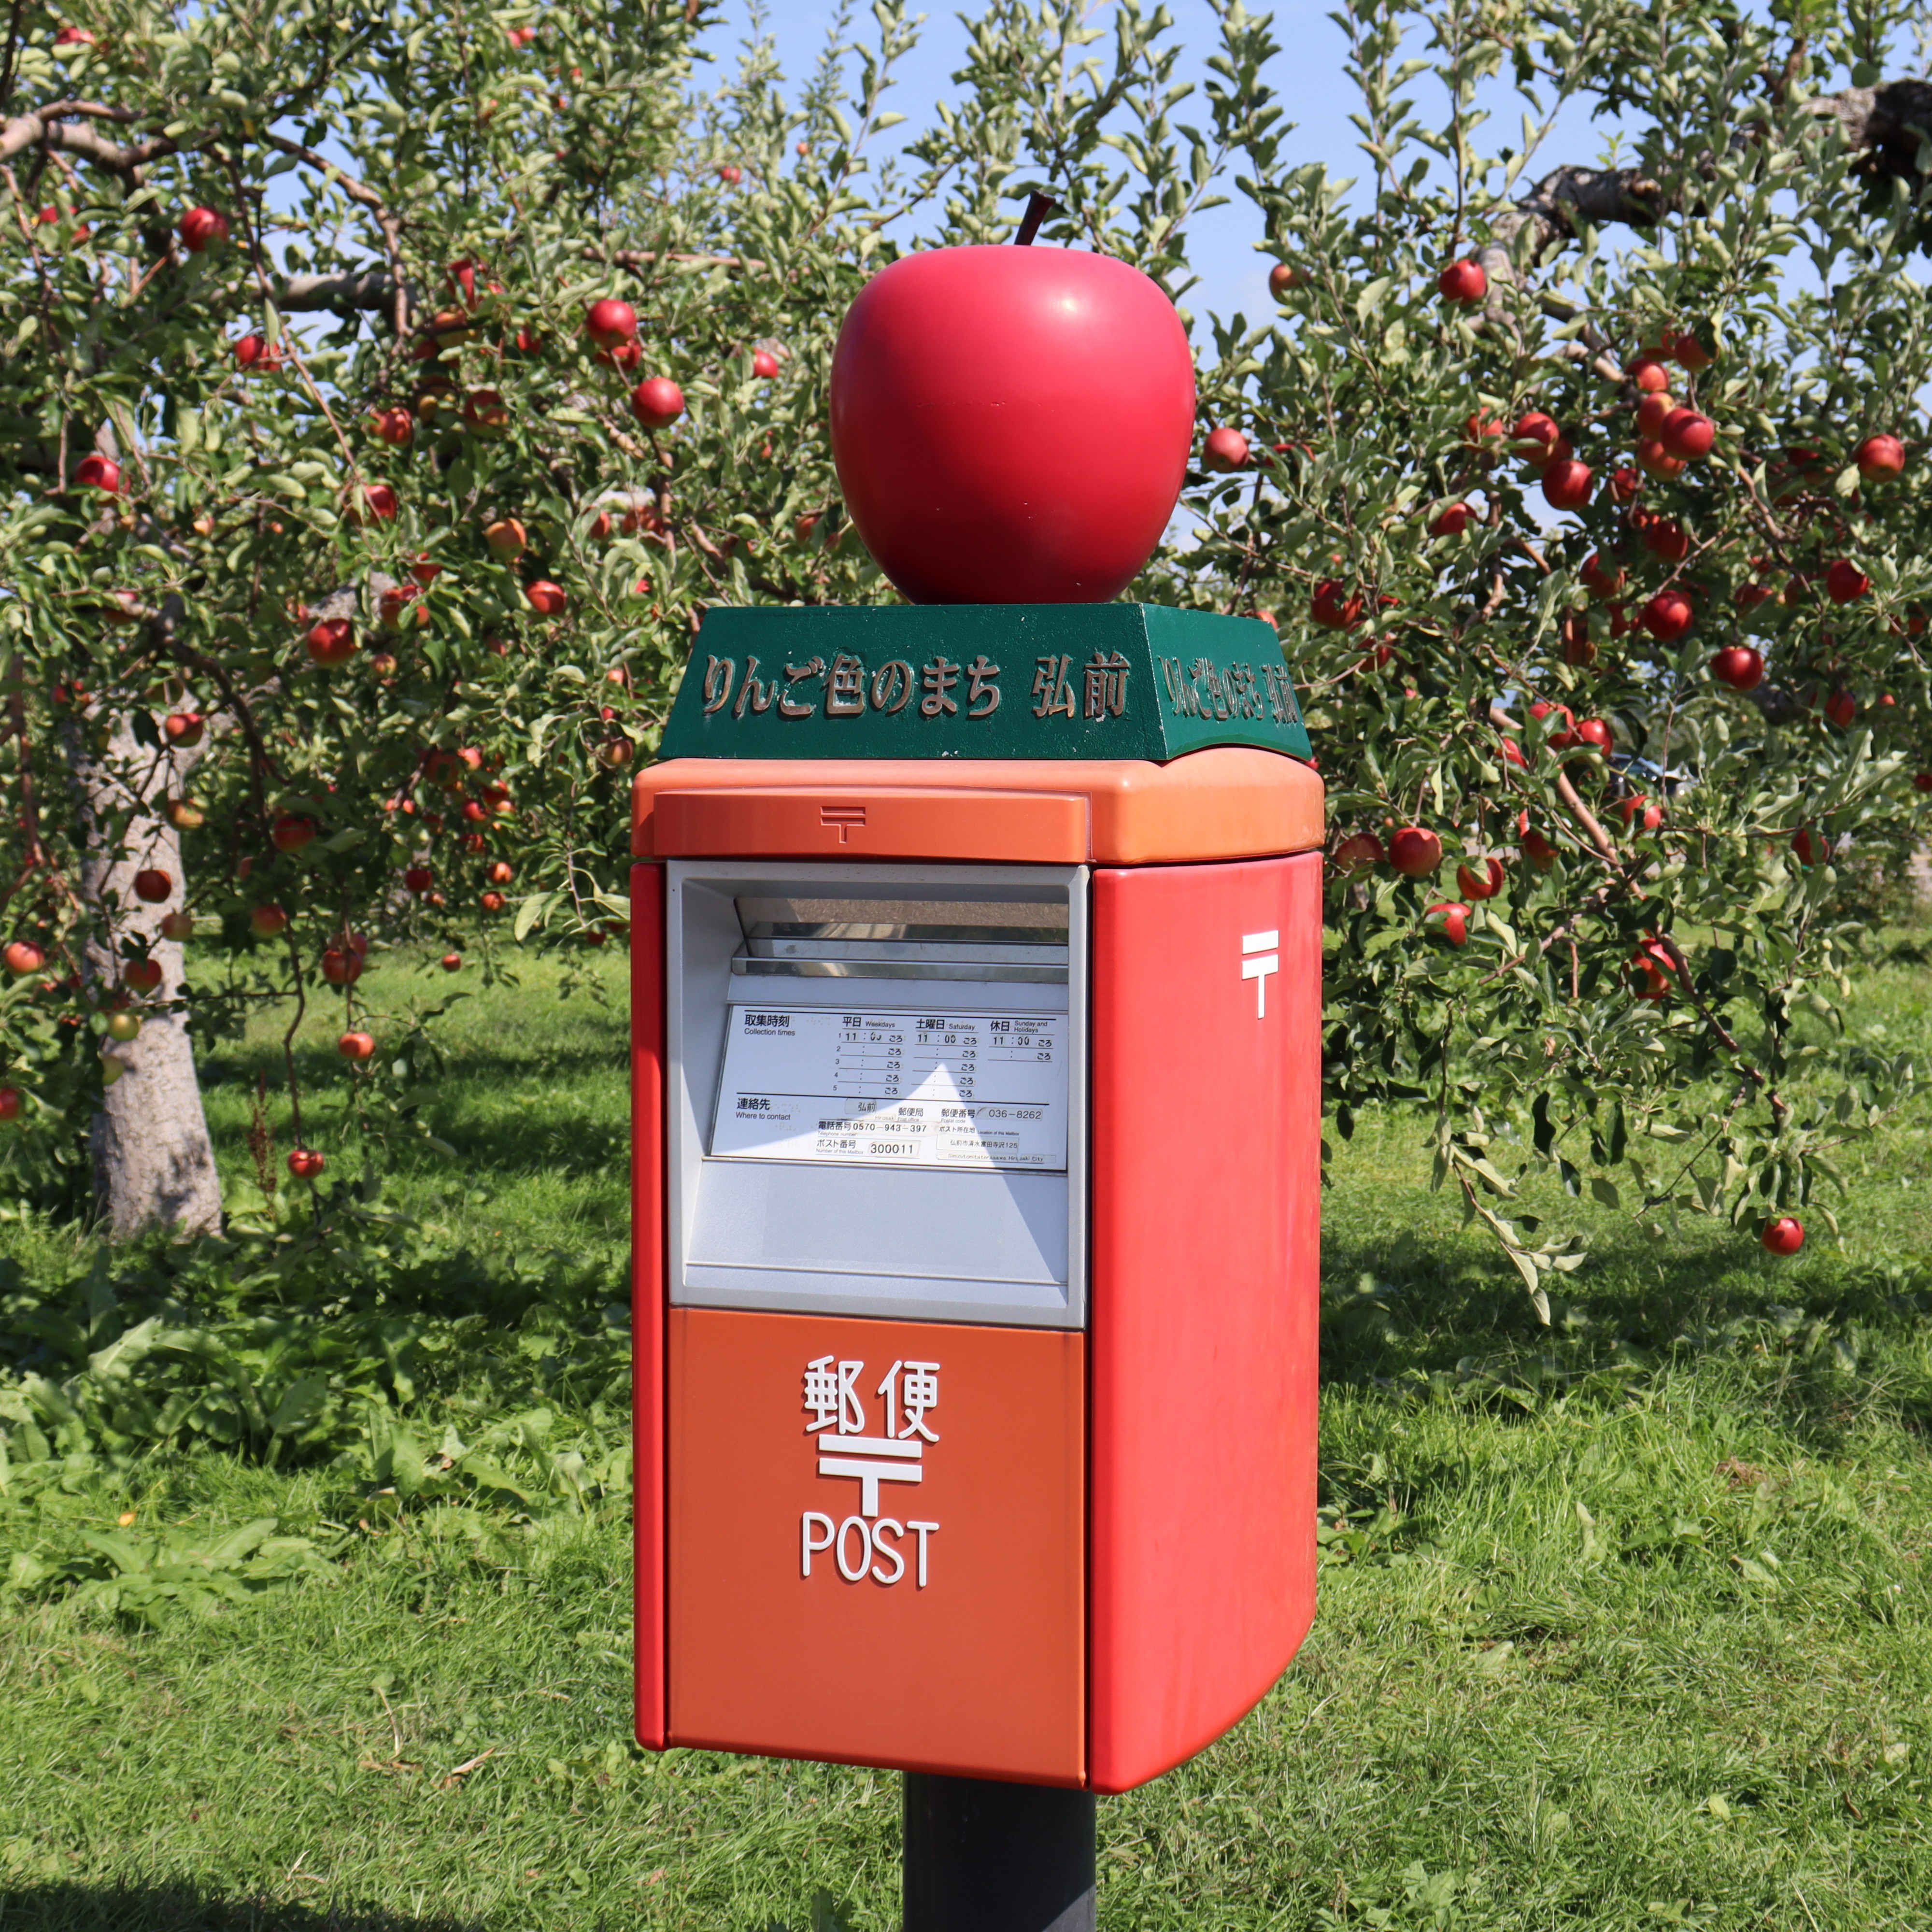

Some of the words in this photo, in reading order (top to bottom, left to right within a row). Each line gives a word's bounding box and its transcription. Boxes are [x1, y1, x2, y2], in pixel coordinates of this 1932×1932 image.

[704, 653, 1000, 715] りんご色のまち
[1032, 651, 1131, 718] 弘前
[744, 1014, 790, 1027] 取集時刻
[842, 1016, 862, 1027] 平日
[915, 1018, 945, 1030] 土曜日
[990, 1020, 1010, 1032] 休日
[737, 1097, 770, 1110] 連絡先
[857, 1102, 876, 1112] 弘前
[898, 1107, 924, 1117] 郵便局
[941, 1108, 975, 1119] 郵便番号
[988, 1109, 1042, 1120] 036-8262
[818, 1121, 852, 1131] 電話番号
[816, 1138, 856, 1149] ポスト番号
[870, 1143, 913, 1154] 300011
[804, 1355, 940, 1443] 郵便
[802, 1511, 940, 1588] POST
